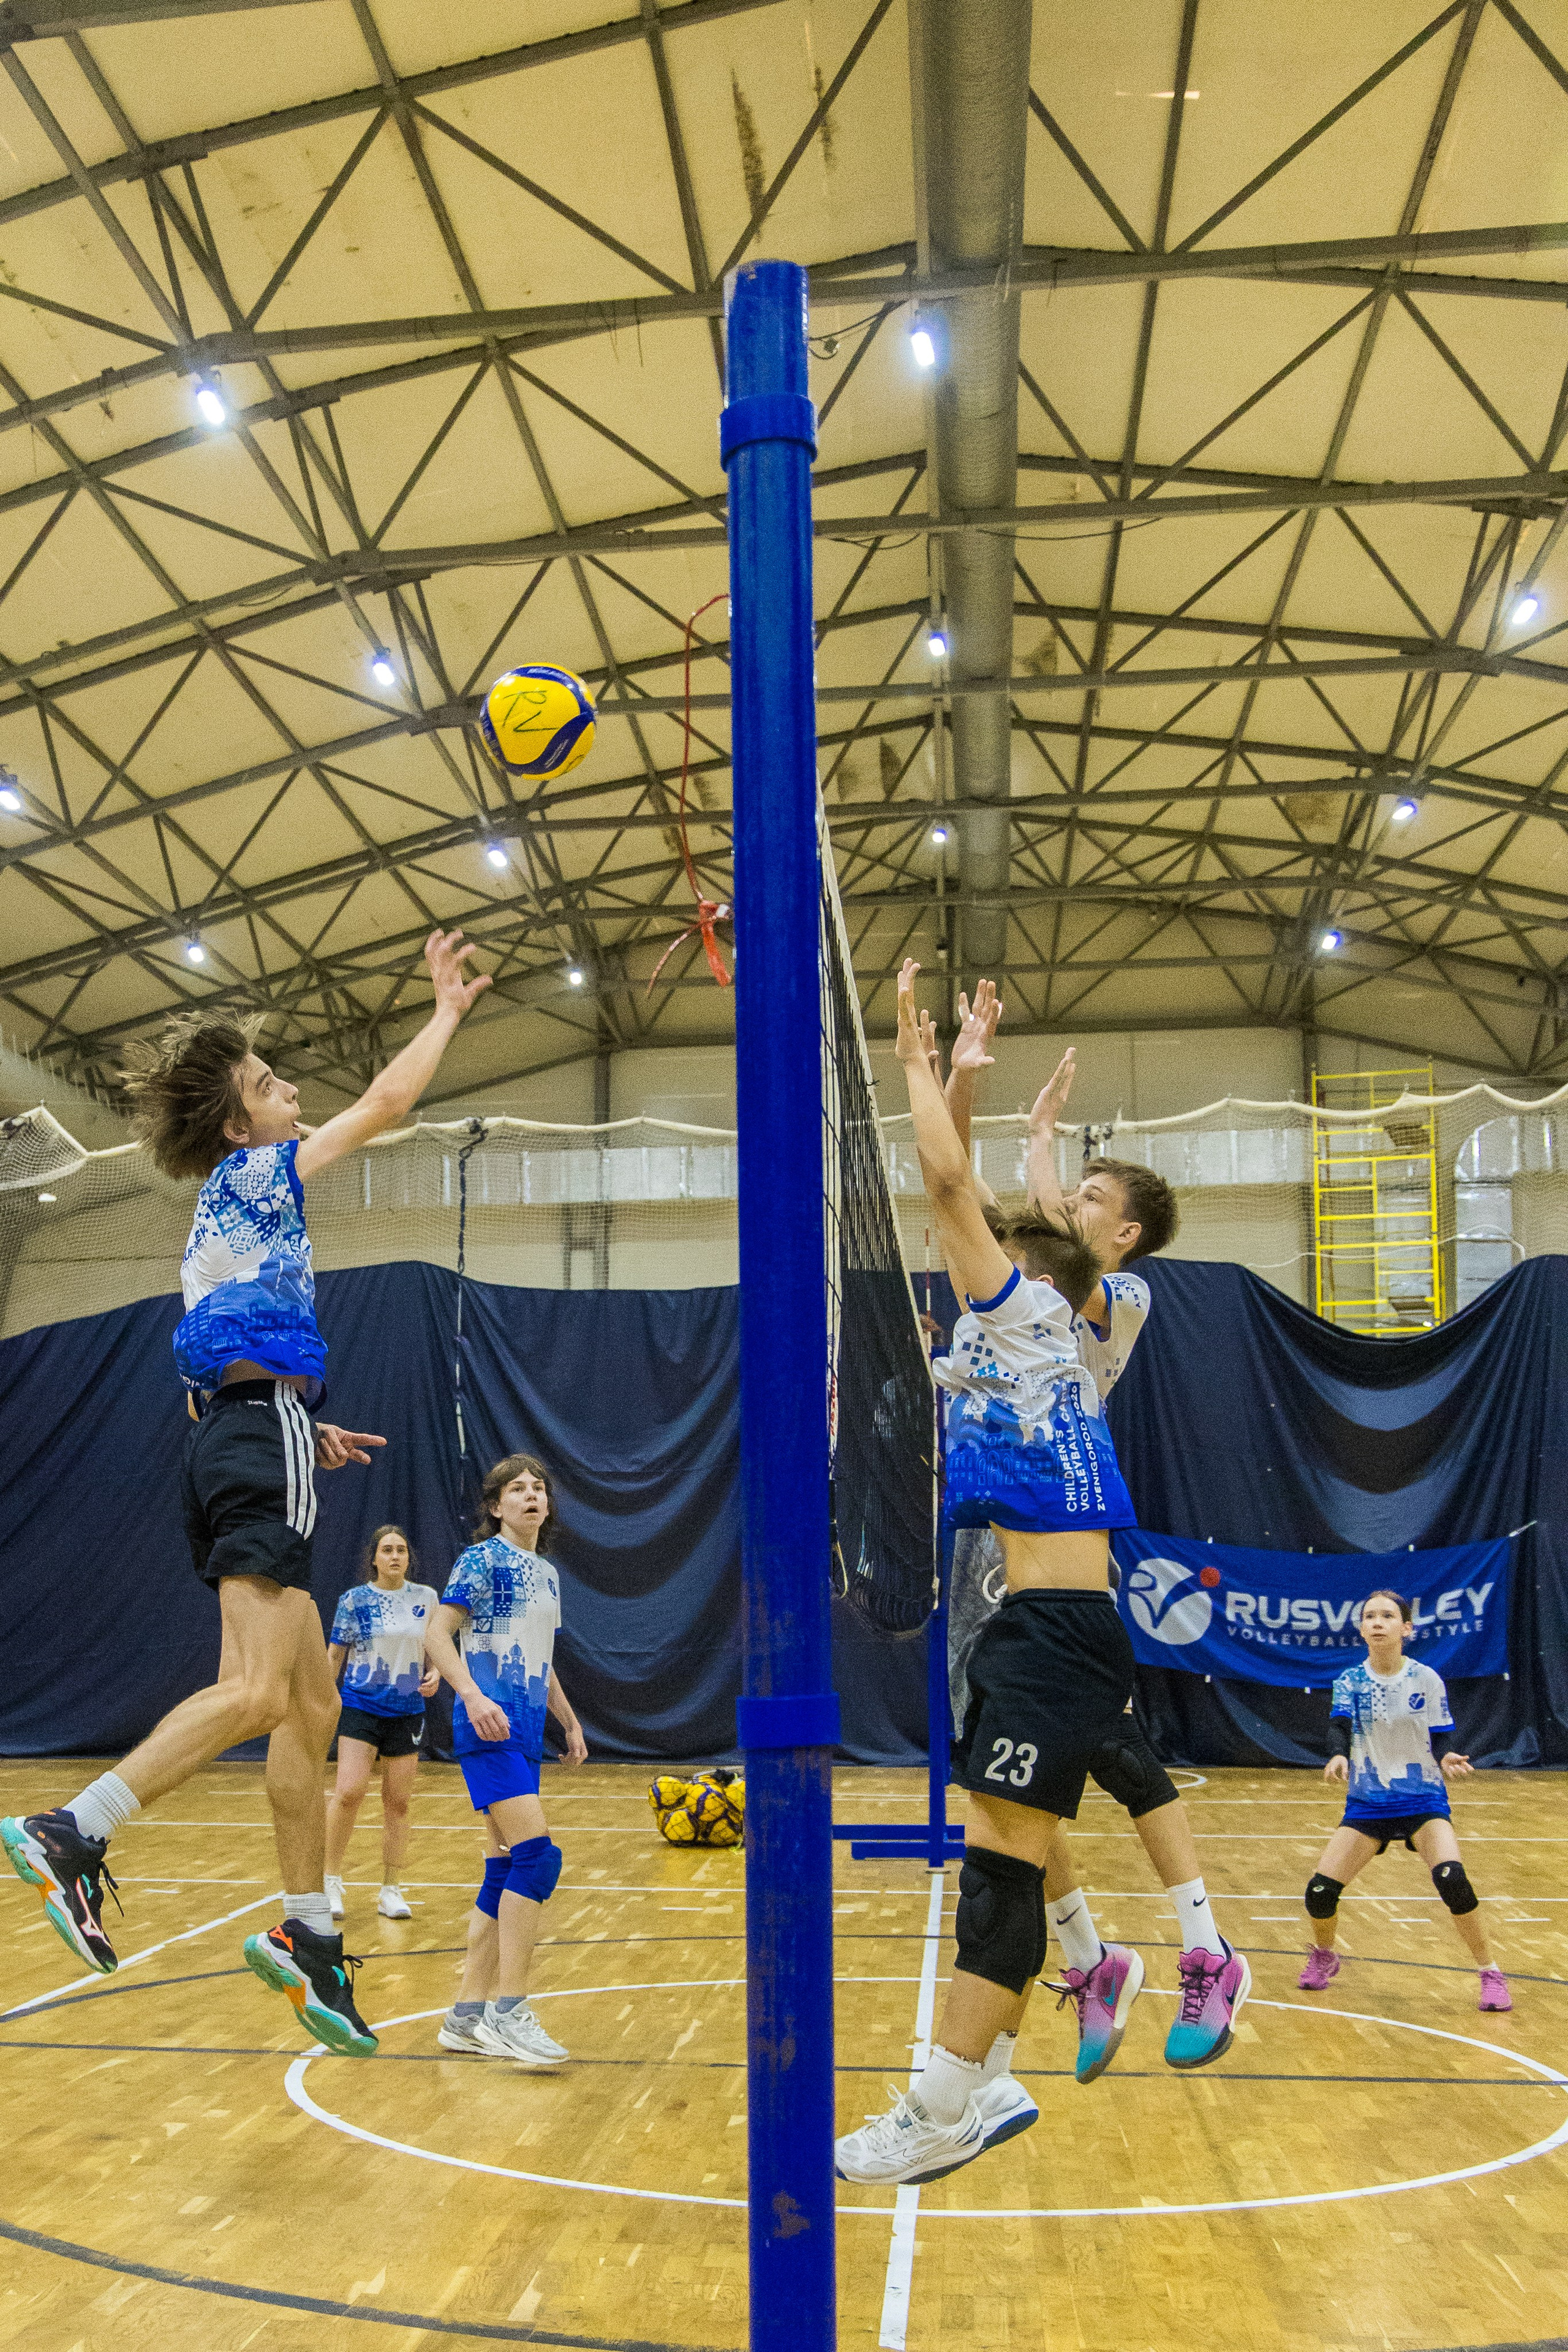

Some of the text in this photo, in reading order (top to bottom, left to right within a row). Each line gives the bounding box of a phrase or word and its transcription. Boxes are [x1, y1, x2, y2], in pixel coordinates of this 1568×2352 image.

[1056, 1430, 1077, 1512] CHILDREN'S
[1066, 1425, 1090, 1511] VOLLEYBALL
[1071, 1385, 1106, 1511] ZVENIGOROD 2020
[1226, 1582, 1494, 1632] RUSVLEY
[1227, 1625, 1362, 1647] VOLLEYBALL
[984, 1738, 1038, 1787] 23
